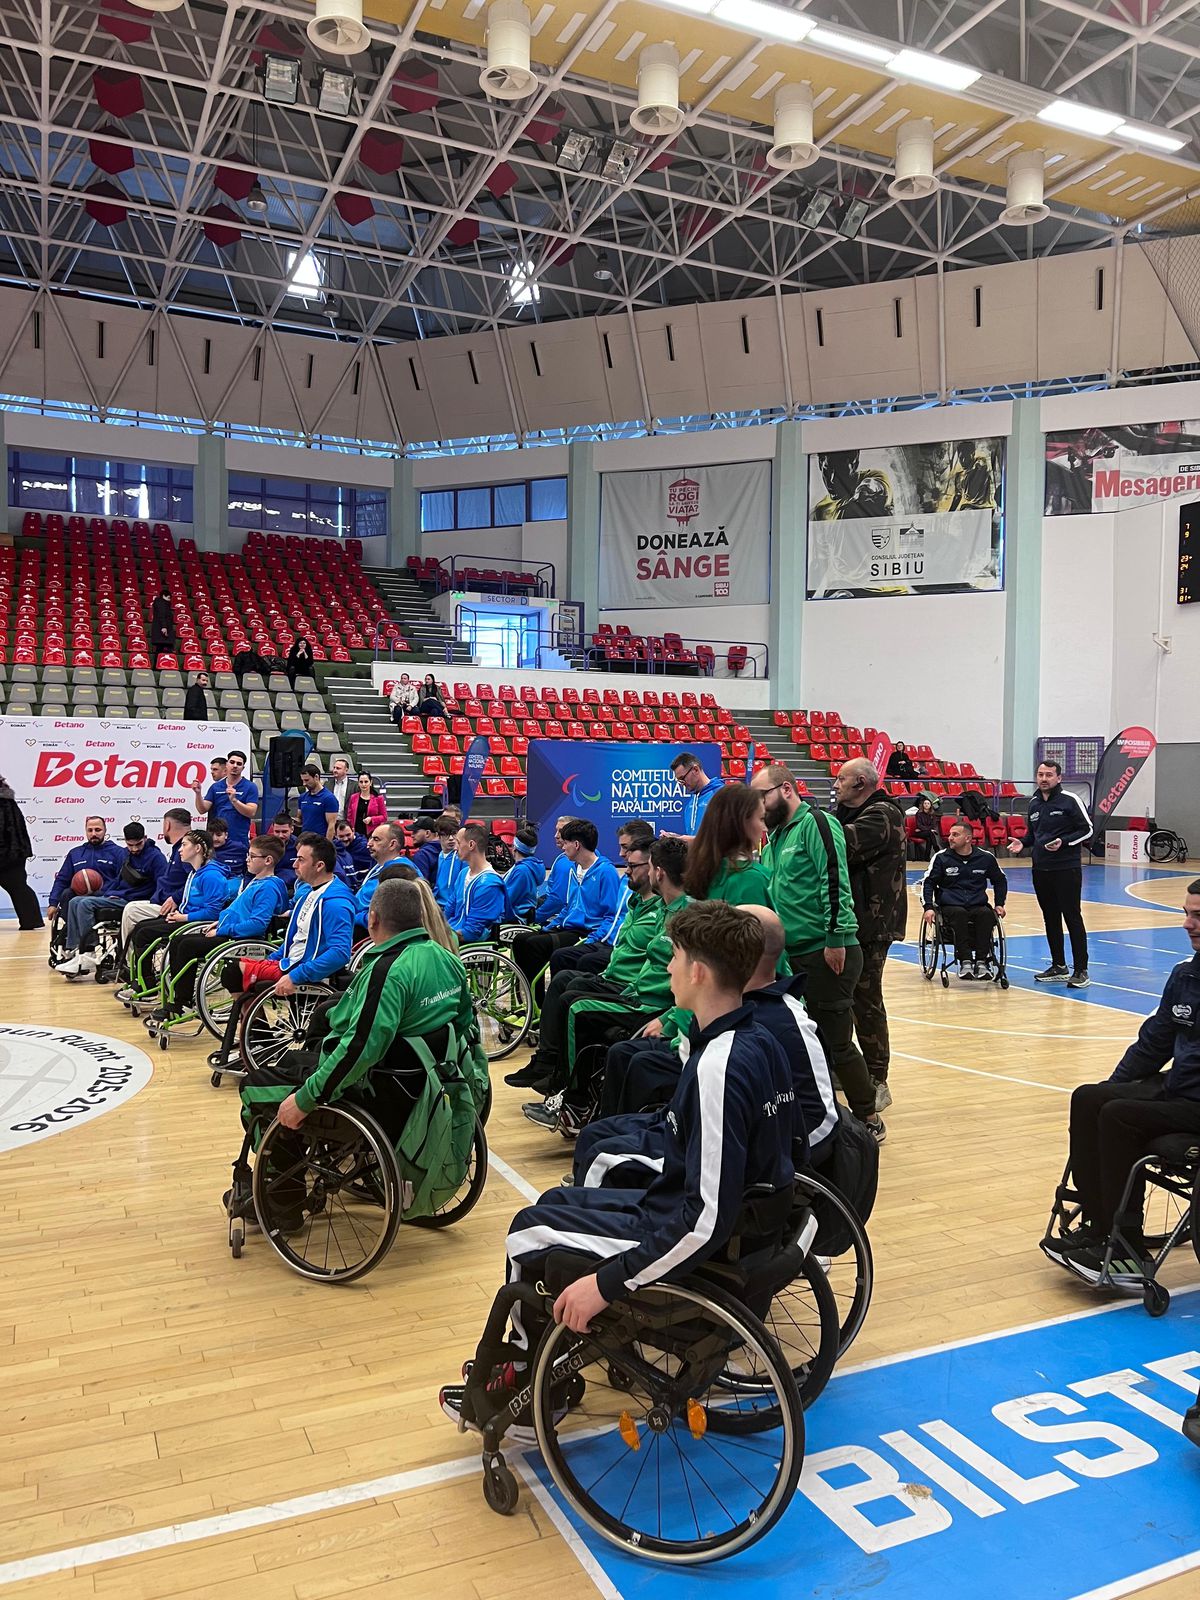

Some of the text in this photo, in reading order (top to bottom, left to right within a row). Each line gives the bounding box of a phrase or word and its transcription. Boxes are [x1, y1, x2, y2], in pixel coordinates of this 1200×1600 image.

[669, 491, 699, 502] ROGI
[636, 525, 730, 551] DONEAZĂ
[636, 549, 730, 580] SÂNGE
[870, 560, 924, 577] SIBIU
[487, 595, 528, 605] SECTOR D
[157, 723, 186, 731] Betano
[186, 742, 215, 750] Betano
[33, 751, 207, 789] Betano
[611, 769, 677, 782] COMITETU
[611, 782, 691, 801] NAȚIONAL
[1098, 766, 1136, 814] Betano
[54, 796, 85, 804] Betano
[157, 796, 186, 804] Betano
[611, 800, 683, 813] PARALIMPIC
[54, 834, 85, 842] Betano
[1131, 834, 1139, 860] Betano
[235, 946, 248, 957] 23
[50, 1034, 126, 1062] Rulant
[10, 1064, 133, 1133] 2025-2026
